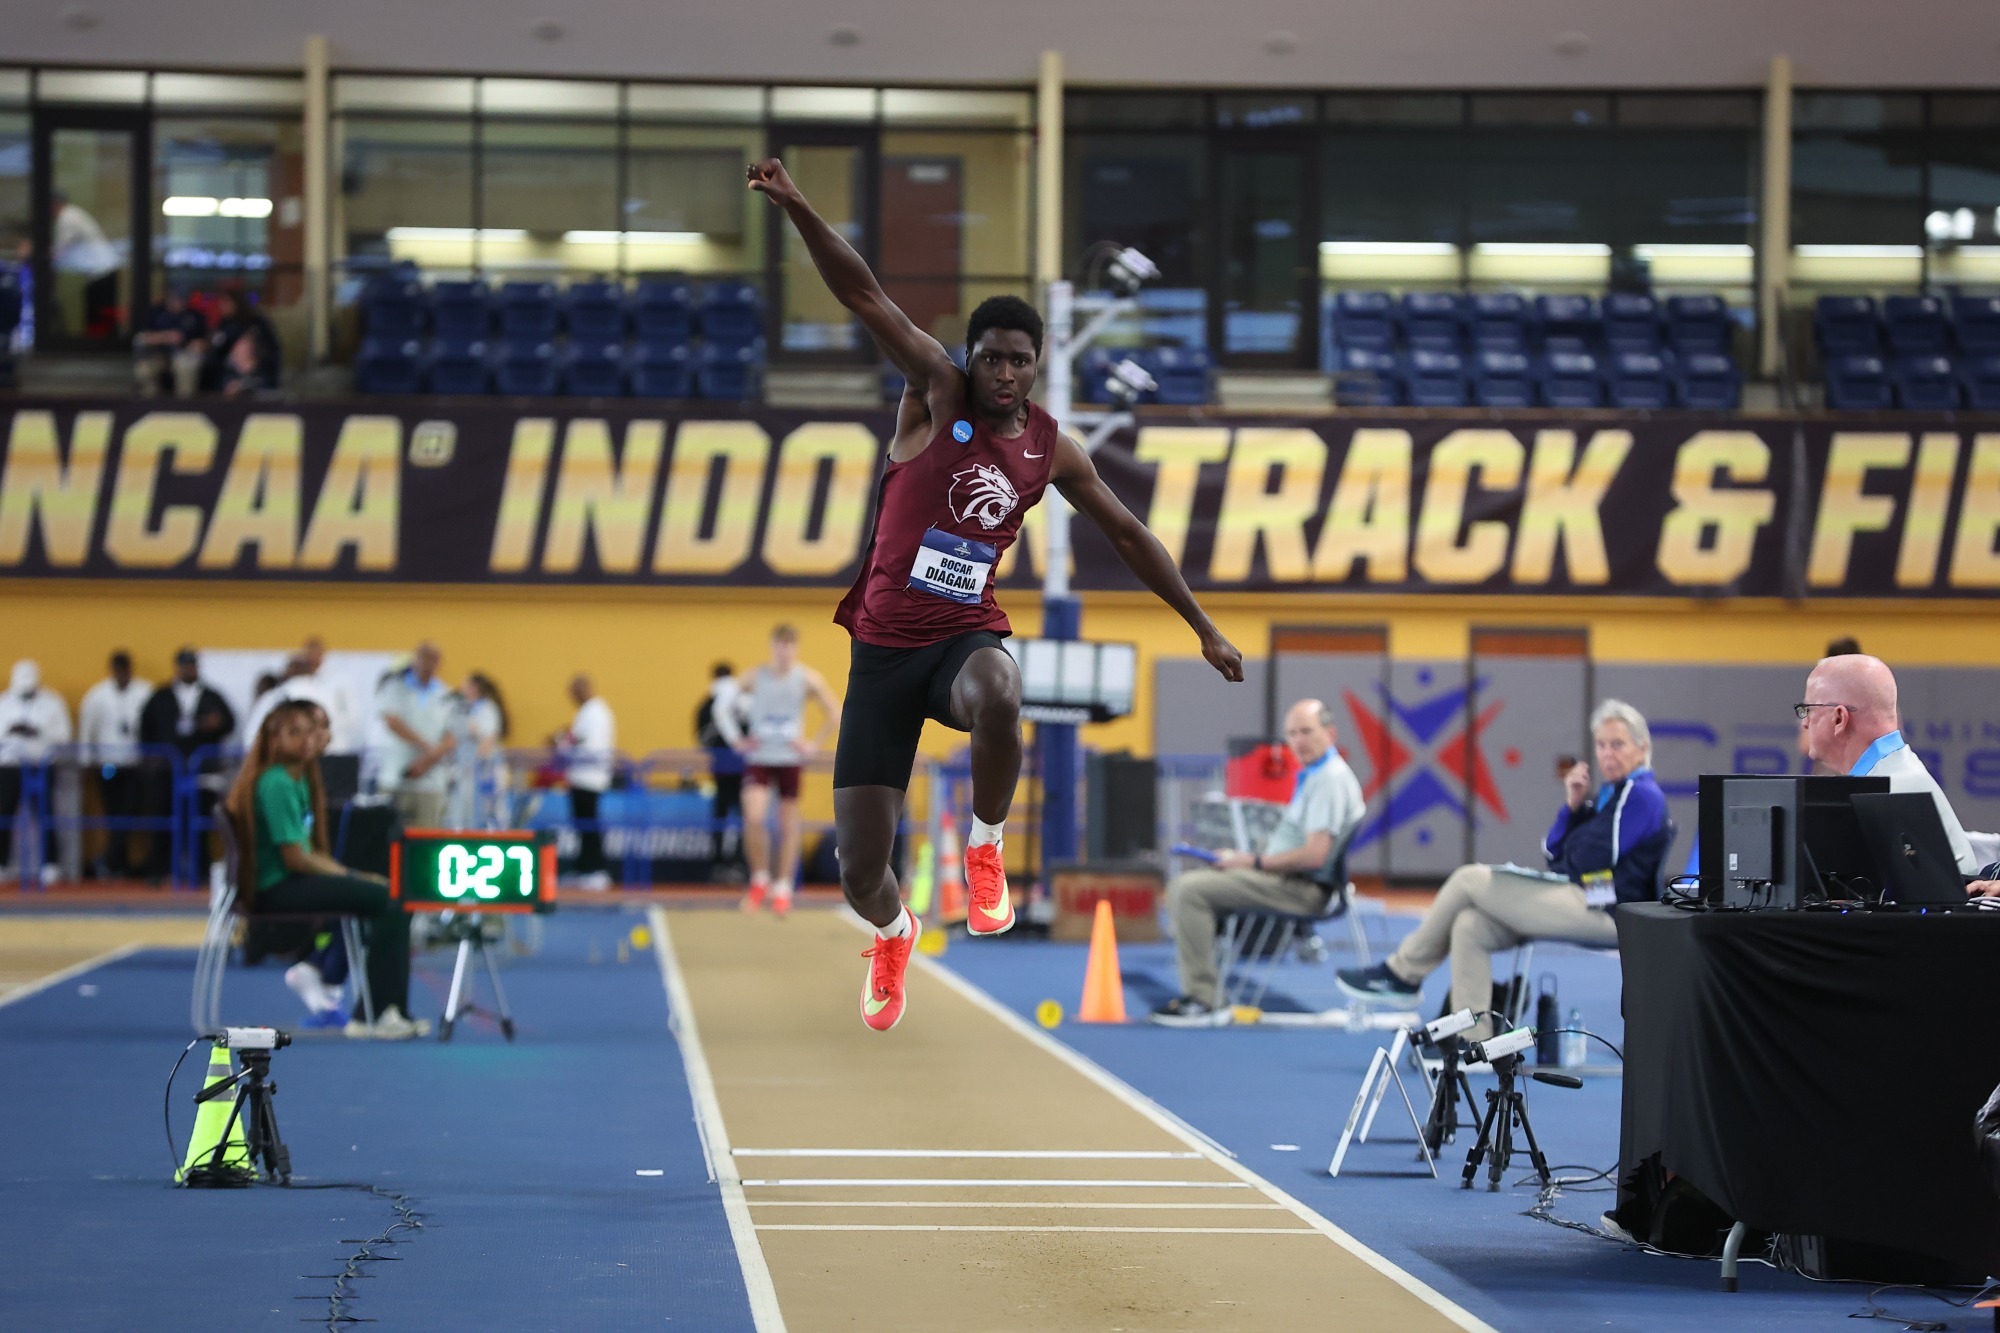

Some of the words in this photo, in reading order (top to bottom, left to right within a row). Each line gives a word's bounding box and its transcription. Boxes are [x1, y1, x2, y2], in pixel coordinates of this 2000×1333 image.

[1135, 427, 1632, 586] TRACK
[1656, 430, 1776, 586] &
[925, 566, 977, 592] DIAGANA
[940, 557, 973, 576] BOCAR
[438, 844, 533, 899] 0:27
